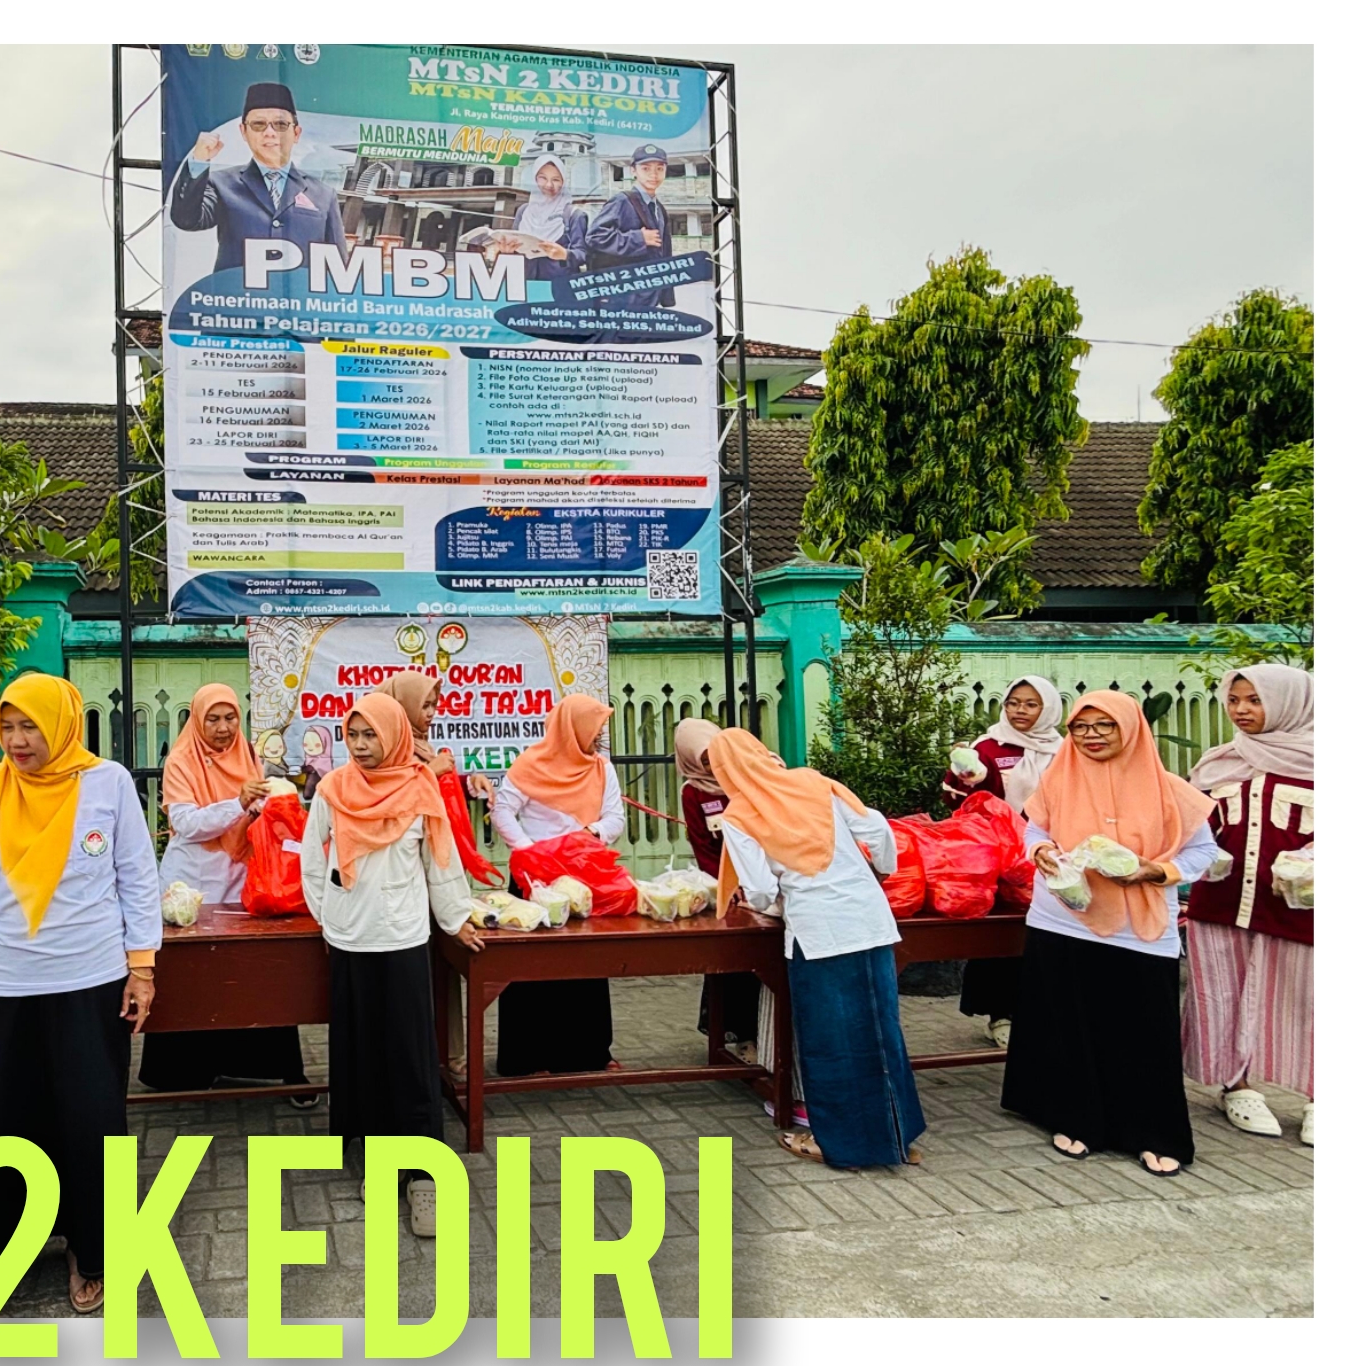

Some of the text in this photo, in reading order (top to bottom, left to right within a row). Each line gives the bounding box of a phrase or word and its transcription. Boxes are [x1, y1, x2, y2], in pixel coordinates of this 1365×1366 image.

[410, 45, 680, 77] KEMENTERIAN AGAMA REPUBLIK INDONESIA
[408, 57, 680, 99] MTsN 2 KEDIRI
[409, 81, 680, 115] MTsN KANIGORO
[490, 103, 607, 117] TERAKREDITASI A
[464, 109, 488, 121] Raya
[491, 111, 535, 124] Kanigoro
[539, 114, 560, 123] Kras
[562, 115, 584, 126] Kab.
[586, 117, 614, 128] Kediri
[617, 121, 652, 132] (64172)
[359, 123, 524, 164] MADRASAH Maju
[362, 146, 488, 164] BERMUTU MENDUNIA
[243, 237, 527, 302] PMBM
[569, 258, 695, 289] MTsN 2 KEDIRI
[575, 272, 691, 301] BERKARISMA
[448, 663, 523, 685] QUR'AN
[301, 692, 353, 720] DAN
[447, 722, 519, 739] PERSATUAN
